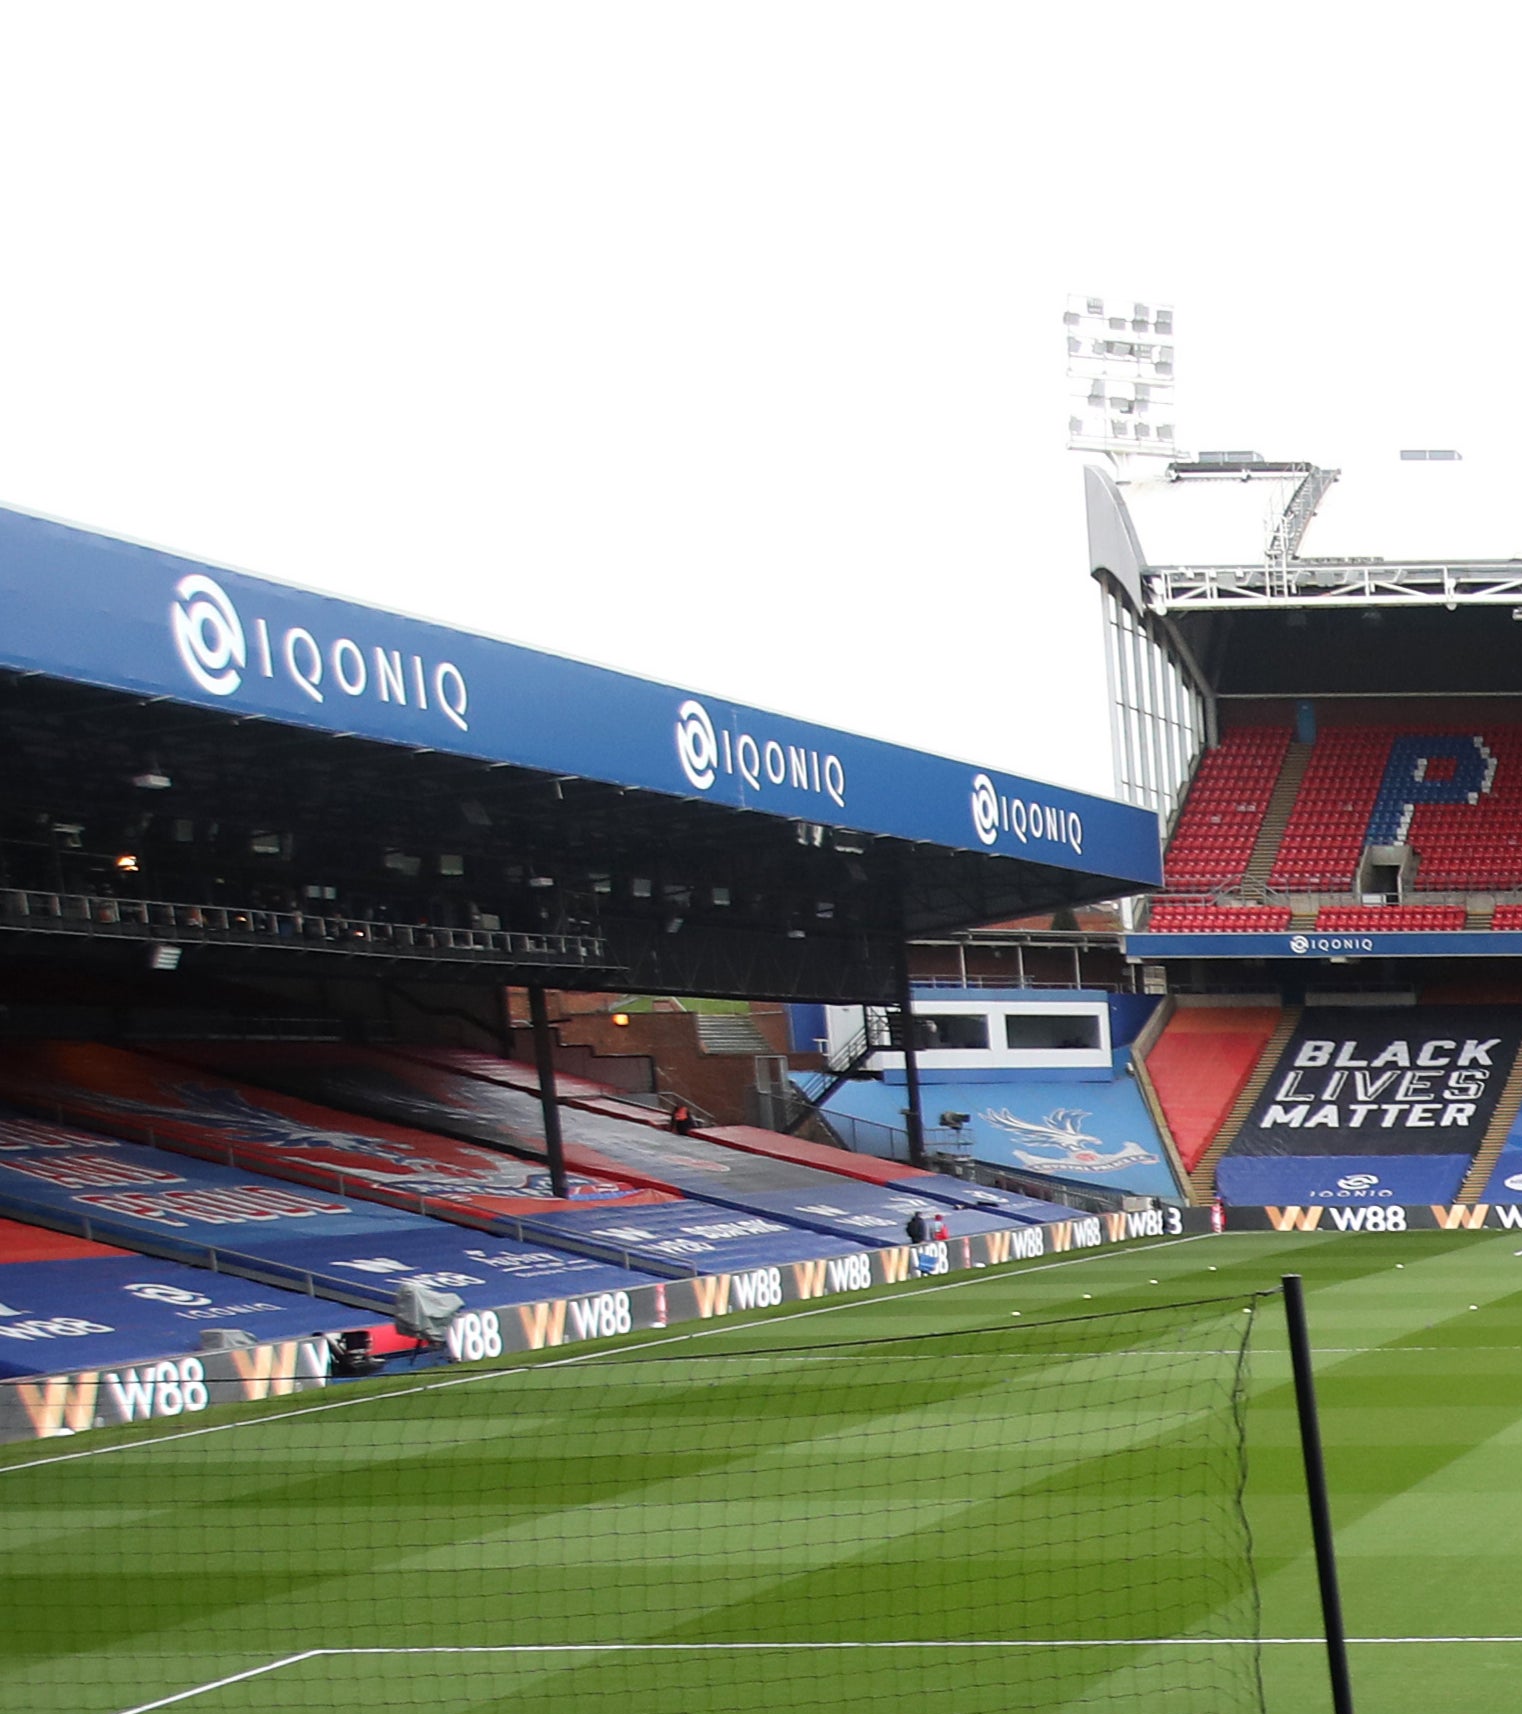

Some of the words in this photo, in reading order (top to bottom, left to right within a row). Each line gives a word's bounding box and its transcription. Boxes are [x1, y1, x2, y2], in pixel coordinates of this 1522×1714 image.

[258, 617, 468, 732] IQONIQ
[723, 730, 846, 807] IQONIQ
[1003, 797, 1084, 856] IQONIQ
[1311, 937, 1374, 951] IQONIQ
[1293, 1038, 1502, 1068] BLACK
[1274, 1068, 1490, 1103] LIVES
[1259, 1103, 1477, 1129] MATTER
[1328, 1205, 1408, 1232] W88
[828, 1252, 872, 1293] W88
[1012, 1226, 1044, 1260] W88
[1072, 1217, 1101, 1249] W88
[571, 1290, 632, 1342] W88
[732, 1267, 784, 1311] W88
[106, 1357, 209, 1424] W88
